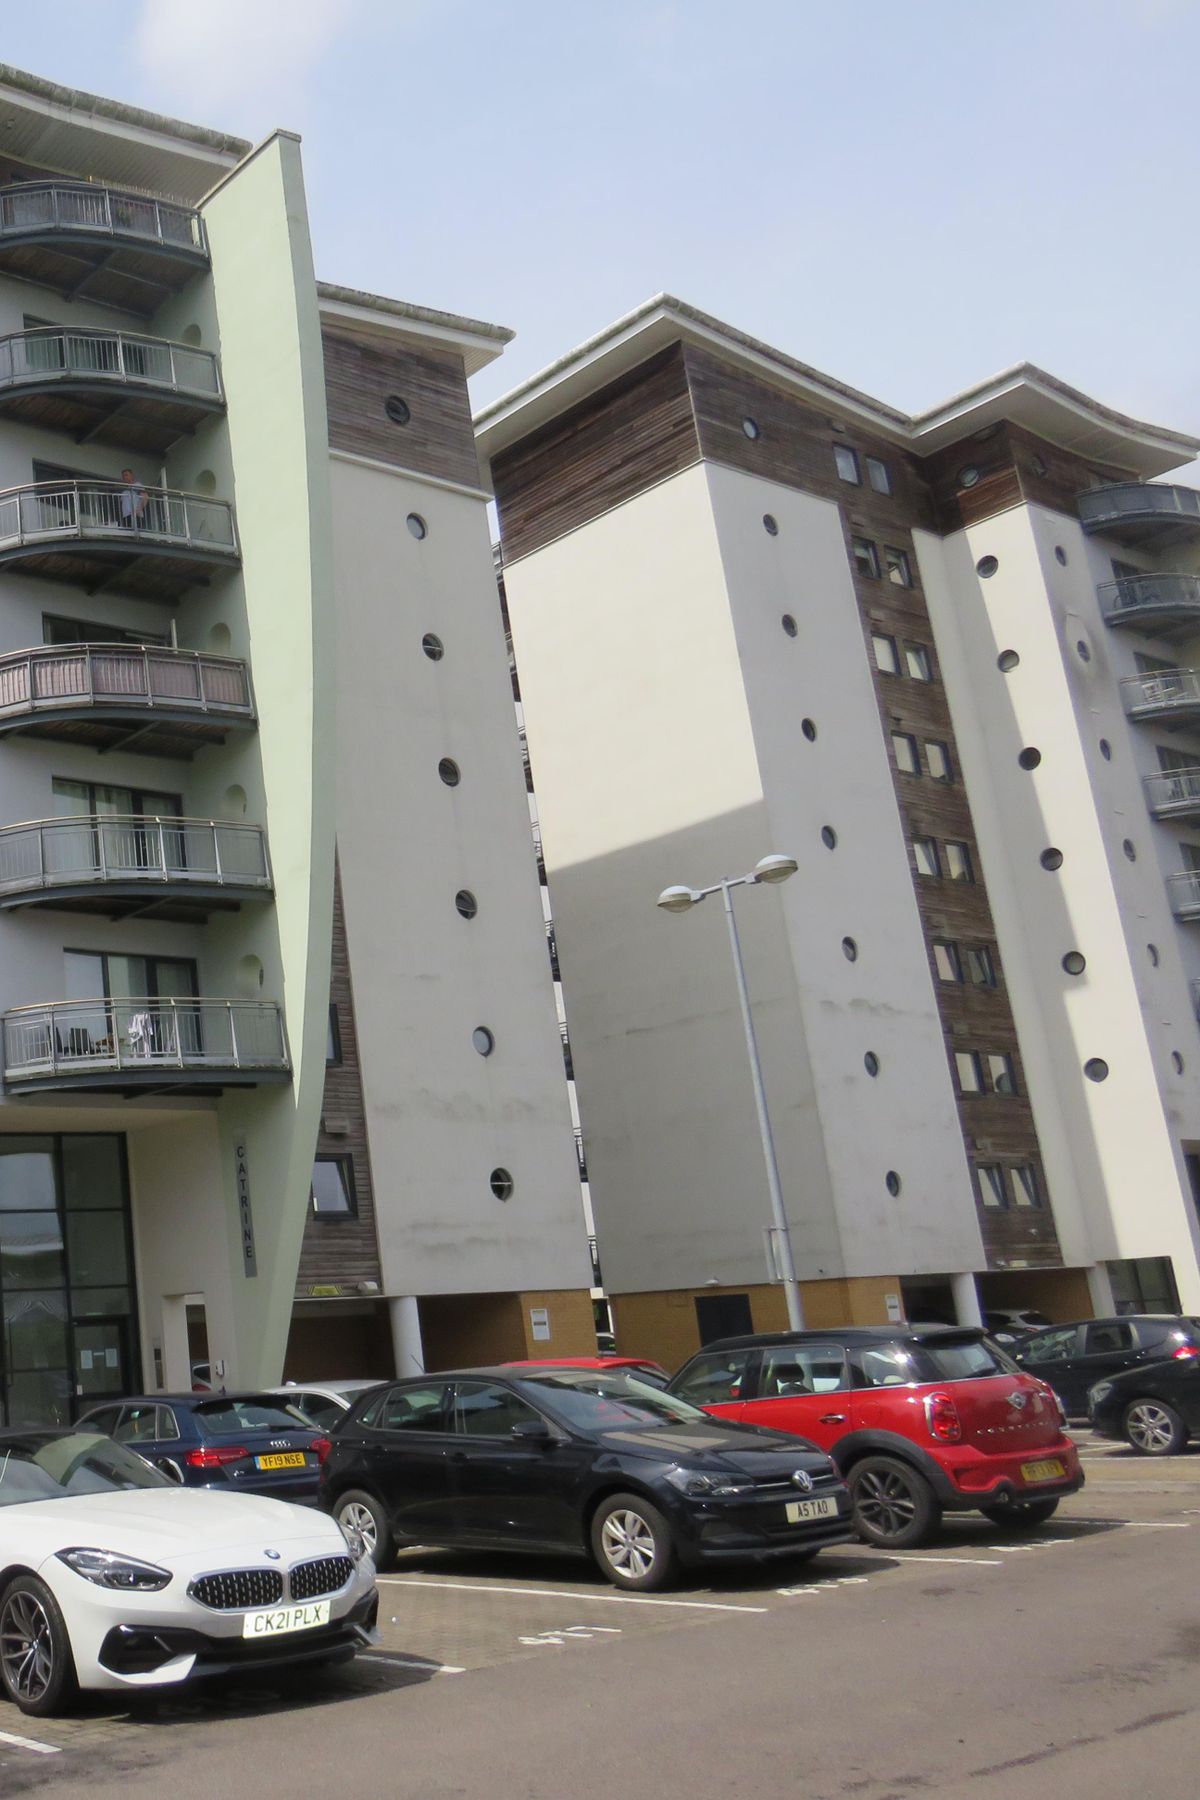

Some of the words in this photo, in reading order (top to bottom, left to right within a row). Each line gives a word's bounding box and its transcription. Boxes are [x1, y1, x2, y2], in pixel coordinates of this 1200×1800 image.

[236, 1145, 253, 1259] CATRINE
[261, 1455, 284, 1468] YF19
[254, 1612, 290, 1632] CK21
[294, 1604, 322, 1627] PLX
